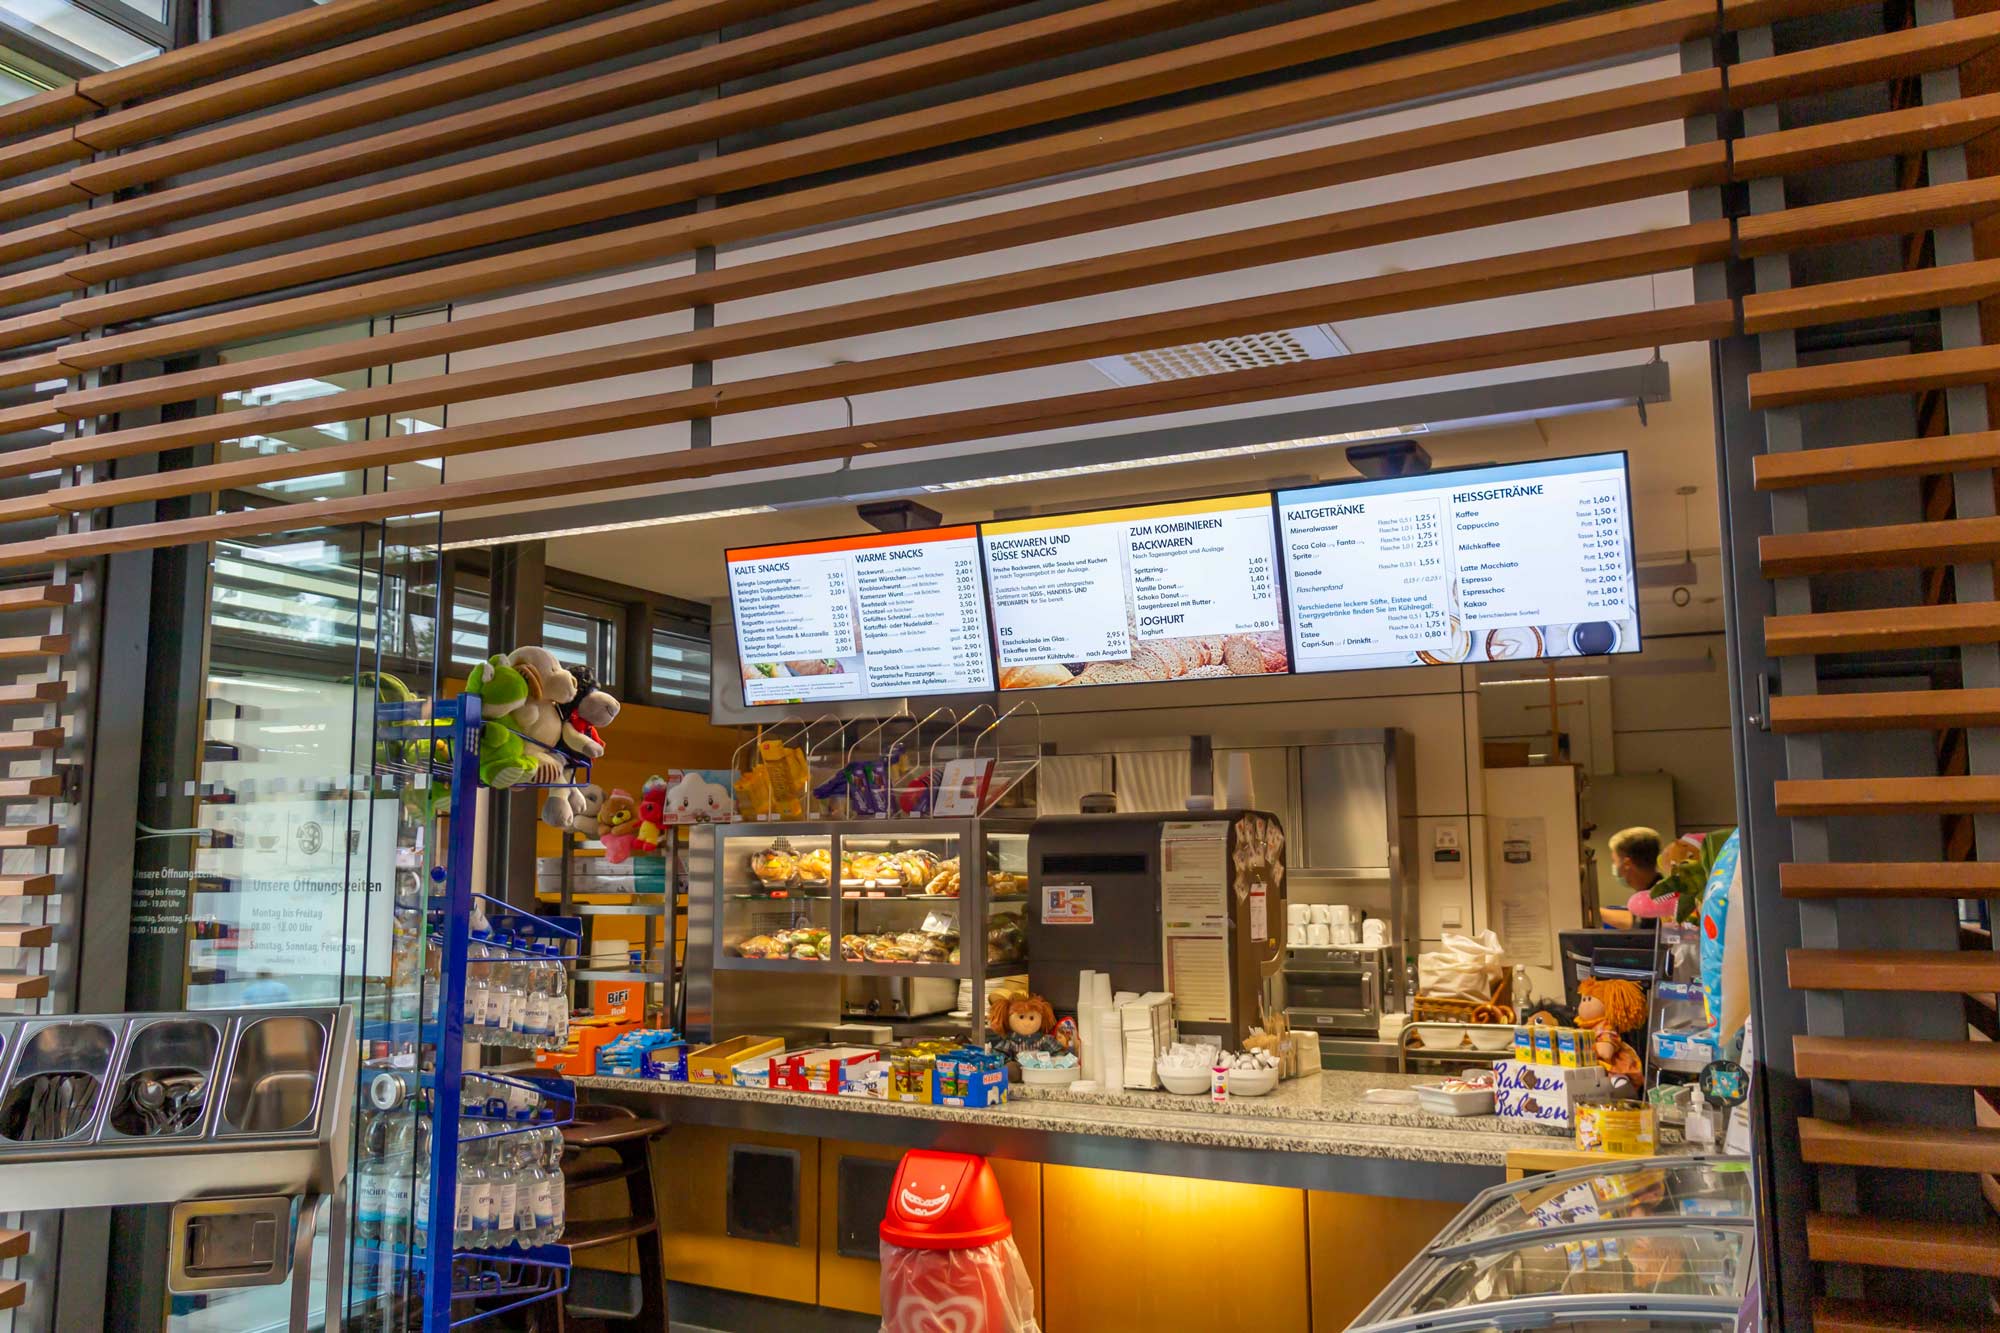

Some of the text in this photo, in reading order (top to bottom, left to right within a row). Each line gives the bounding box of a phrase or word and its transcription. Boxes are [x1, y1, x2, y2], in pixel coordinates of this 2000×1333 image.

[1453, 484, 1543, 504] HEISSGETRÄNKE
[1593, 495, 1609, 504] 1,60
[1287, 503, 1365, 520] KALTGETRÄNKE
[1455, 510, 1478, 518] Kaffee
[1594, 507, 1611, 515] 1,50
[1289, 513, 1430, 534] Mineralwasser 1,25
[1416, 521, 1431, 530] 1,55
[1456, 521, 1499, 530] Cappuccino
[1594, 517, 1611, 525] 1,90
[1130, 519, 1223, 537] ZUM KOMBINIEREN
[1417, 531, 1432, 539] 1,75
[1596, 529, 1612, 537] 1,50
[990, 534, 1070, 550] BACKWAREN UND
[1131, 536, 1192, 551] BACKWAREN
[1416, 539, 1432, 548] 2,25
[1458, 541, 1500, 550] Milchkaffee
[1596, 539, 1613, 547] 1,90
[855, 549, 923, 564] WARME SNACKS
[991, 546, 1057, 561] SÜSSE SNACKS
[1597, 551, 1614, 559] 1,90
[1248, 556, 1263, 564] 1,40
[734, 562, 790, 575] KALTE SNACKS
[1294, 558, 1434, 577] Bionade 1,55
[1480, 561, 1518, 569] Macchiato
[1599, 563, 1615, 571] 1,50
[1135, 584, 1156, 592] Vanille
[1250, 574, 1264, 582] 1,40
[1461, 576, 1492, 584] Espresso
[1598, 574, 1616, 583] 2,00
[1136, 593, 1159, 601] Schoko
[1251, 583, 1265, 591] 1,40
[1296, 583, 1343, 592] Flaschenpfand
[1600, 586, 1617, 594] 1,80
[1137, 600, 1179, 610] Laugenbrezel
[1297, 602, 1341, 610] Verschiedene
[1463, 600, 1487, 608] Kakao
[1601, 598, 1618, 606] 1,00
[1298, 609, 1350, 619] Energygetränke
[1398, 602, 1433, 611] Kühlregal:
[1424, 610, 1439, 618] 1,75
[1139, 613, 1184, 626] JOGHURT
[1426, 620, 1440, 628] 1,75
[999, 626, 1012, 636] EIS
[1141, 620, 1269, 636] Joghurt 0,80
[1106, 630, 1120, 638] 2,95
[1107, 639, 1121, 647] 2,95
[1301, 639, 1334, 648] Capri-Sun
[1424, 630, 1441, 638] 0,80
[1101, 648, 1127, 656] Angebot
[253, 880, 289, 892] Unsere
[608, 990, 628, 1004] BiFi
[1494, 1062, 1564, 1091] Bahsen
[1496, 1090, 1569, 1120] Bahsen
